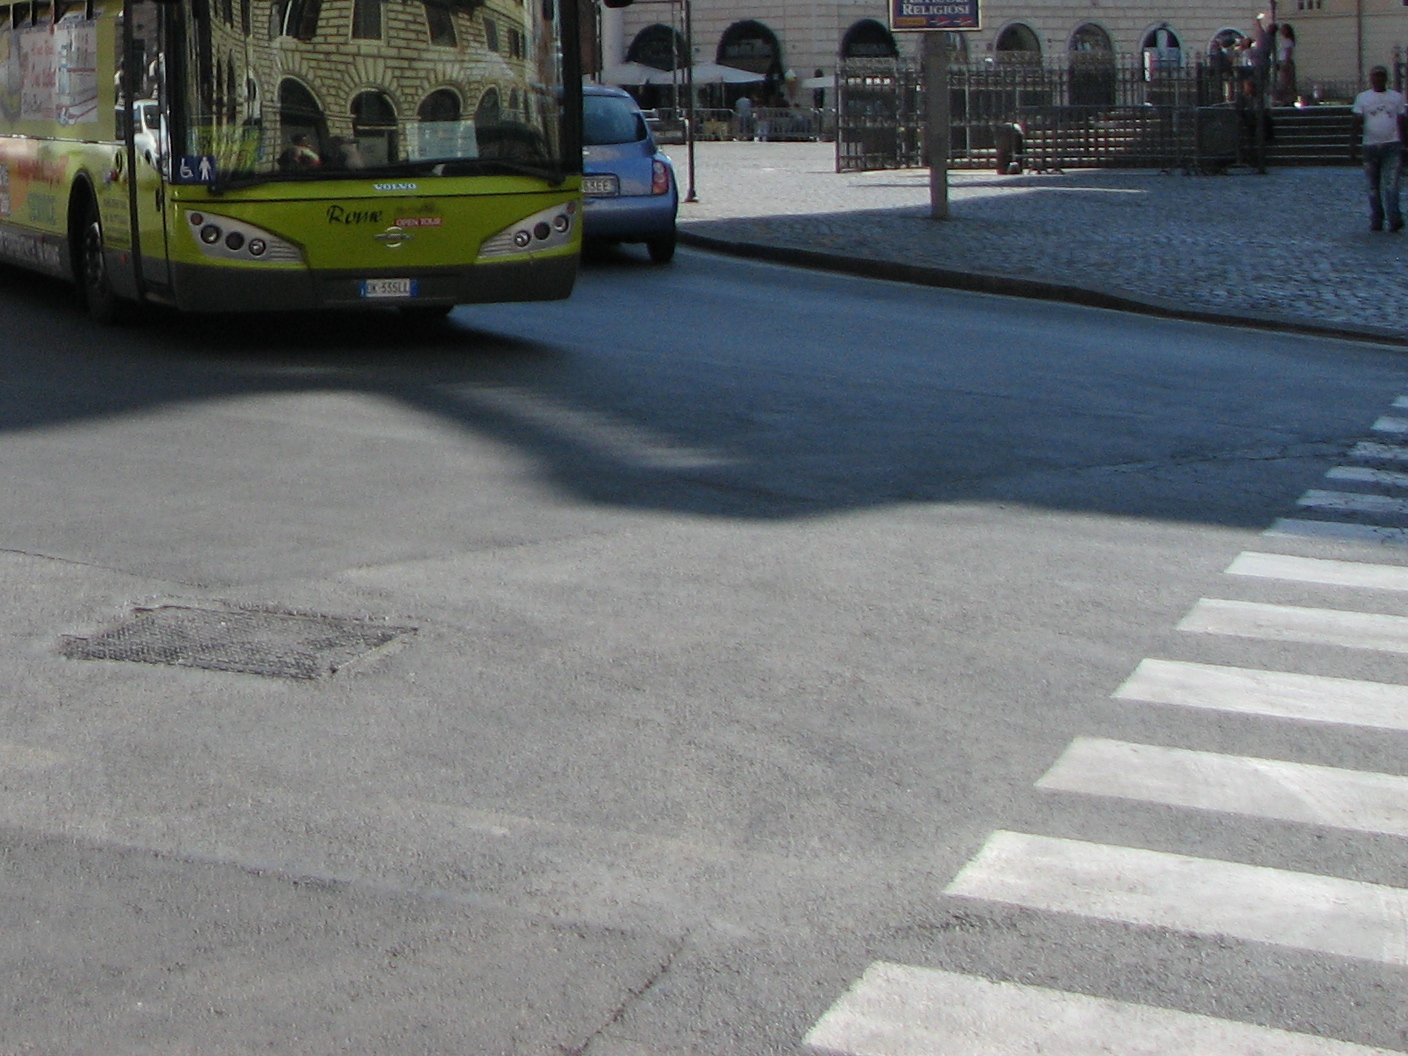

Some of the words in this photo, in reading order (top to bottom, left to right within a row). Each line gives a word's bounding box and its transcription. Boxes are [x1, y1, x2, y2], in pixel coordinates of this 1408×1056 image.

[902, 3, 970, 16] RELIGIOSI
[373, 183, 417, 191] VOLVO
[326, 204, 384, 225] Rome
[396, 218, 418, 227] OPEN
[420, 217, 442, 226] TOUR
